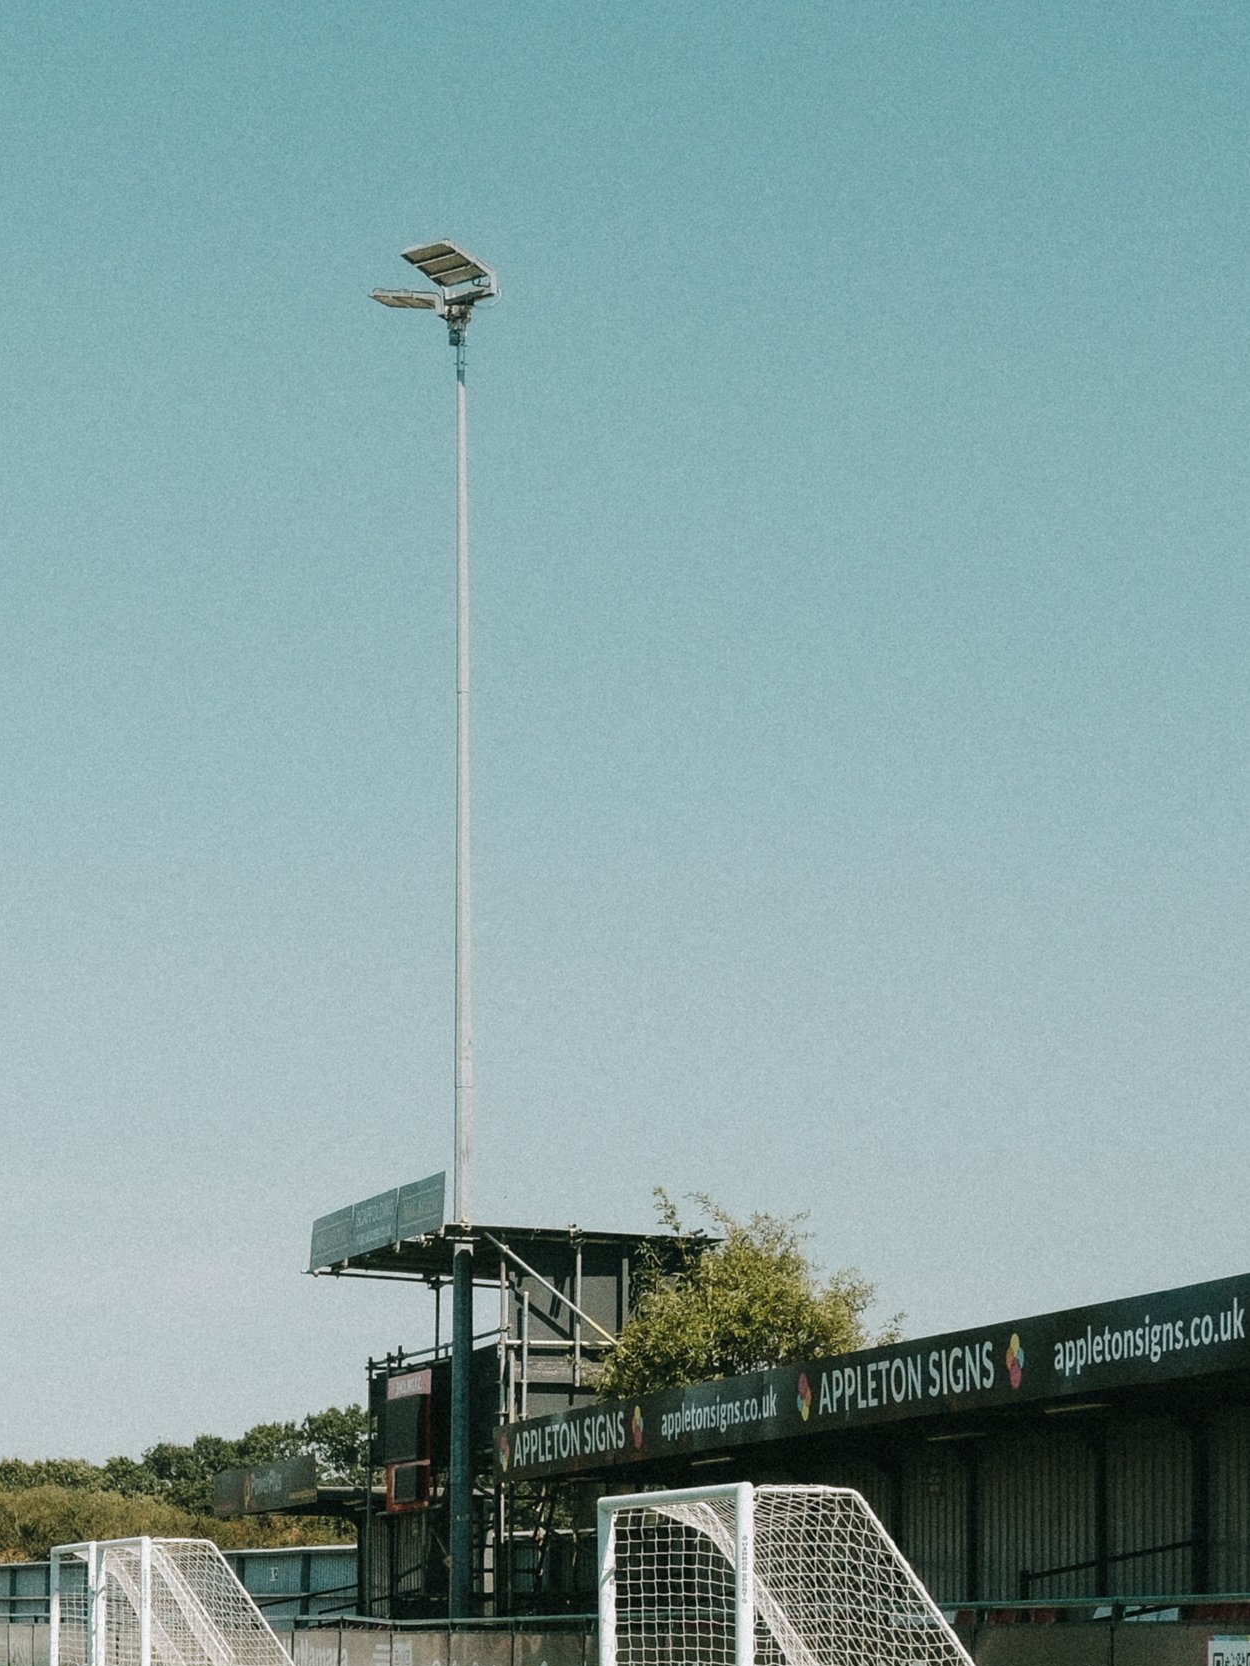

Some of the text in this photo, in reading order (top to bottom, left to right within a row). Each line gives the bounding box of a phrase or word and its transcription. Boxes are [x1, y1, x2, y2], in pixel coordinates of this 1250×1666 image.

[1054, 1297, 1246, 1376] appletonsigns.co.uk
[818, 1340, 995, 1415] APPLETON SIGNS
[513, 1410, 625, 1467] APPLETON SIGNS
[661, 1385, 777, 1441] appletonsigns.co.uk
